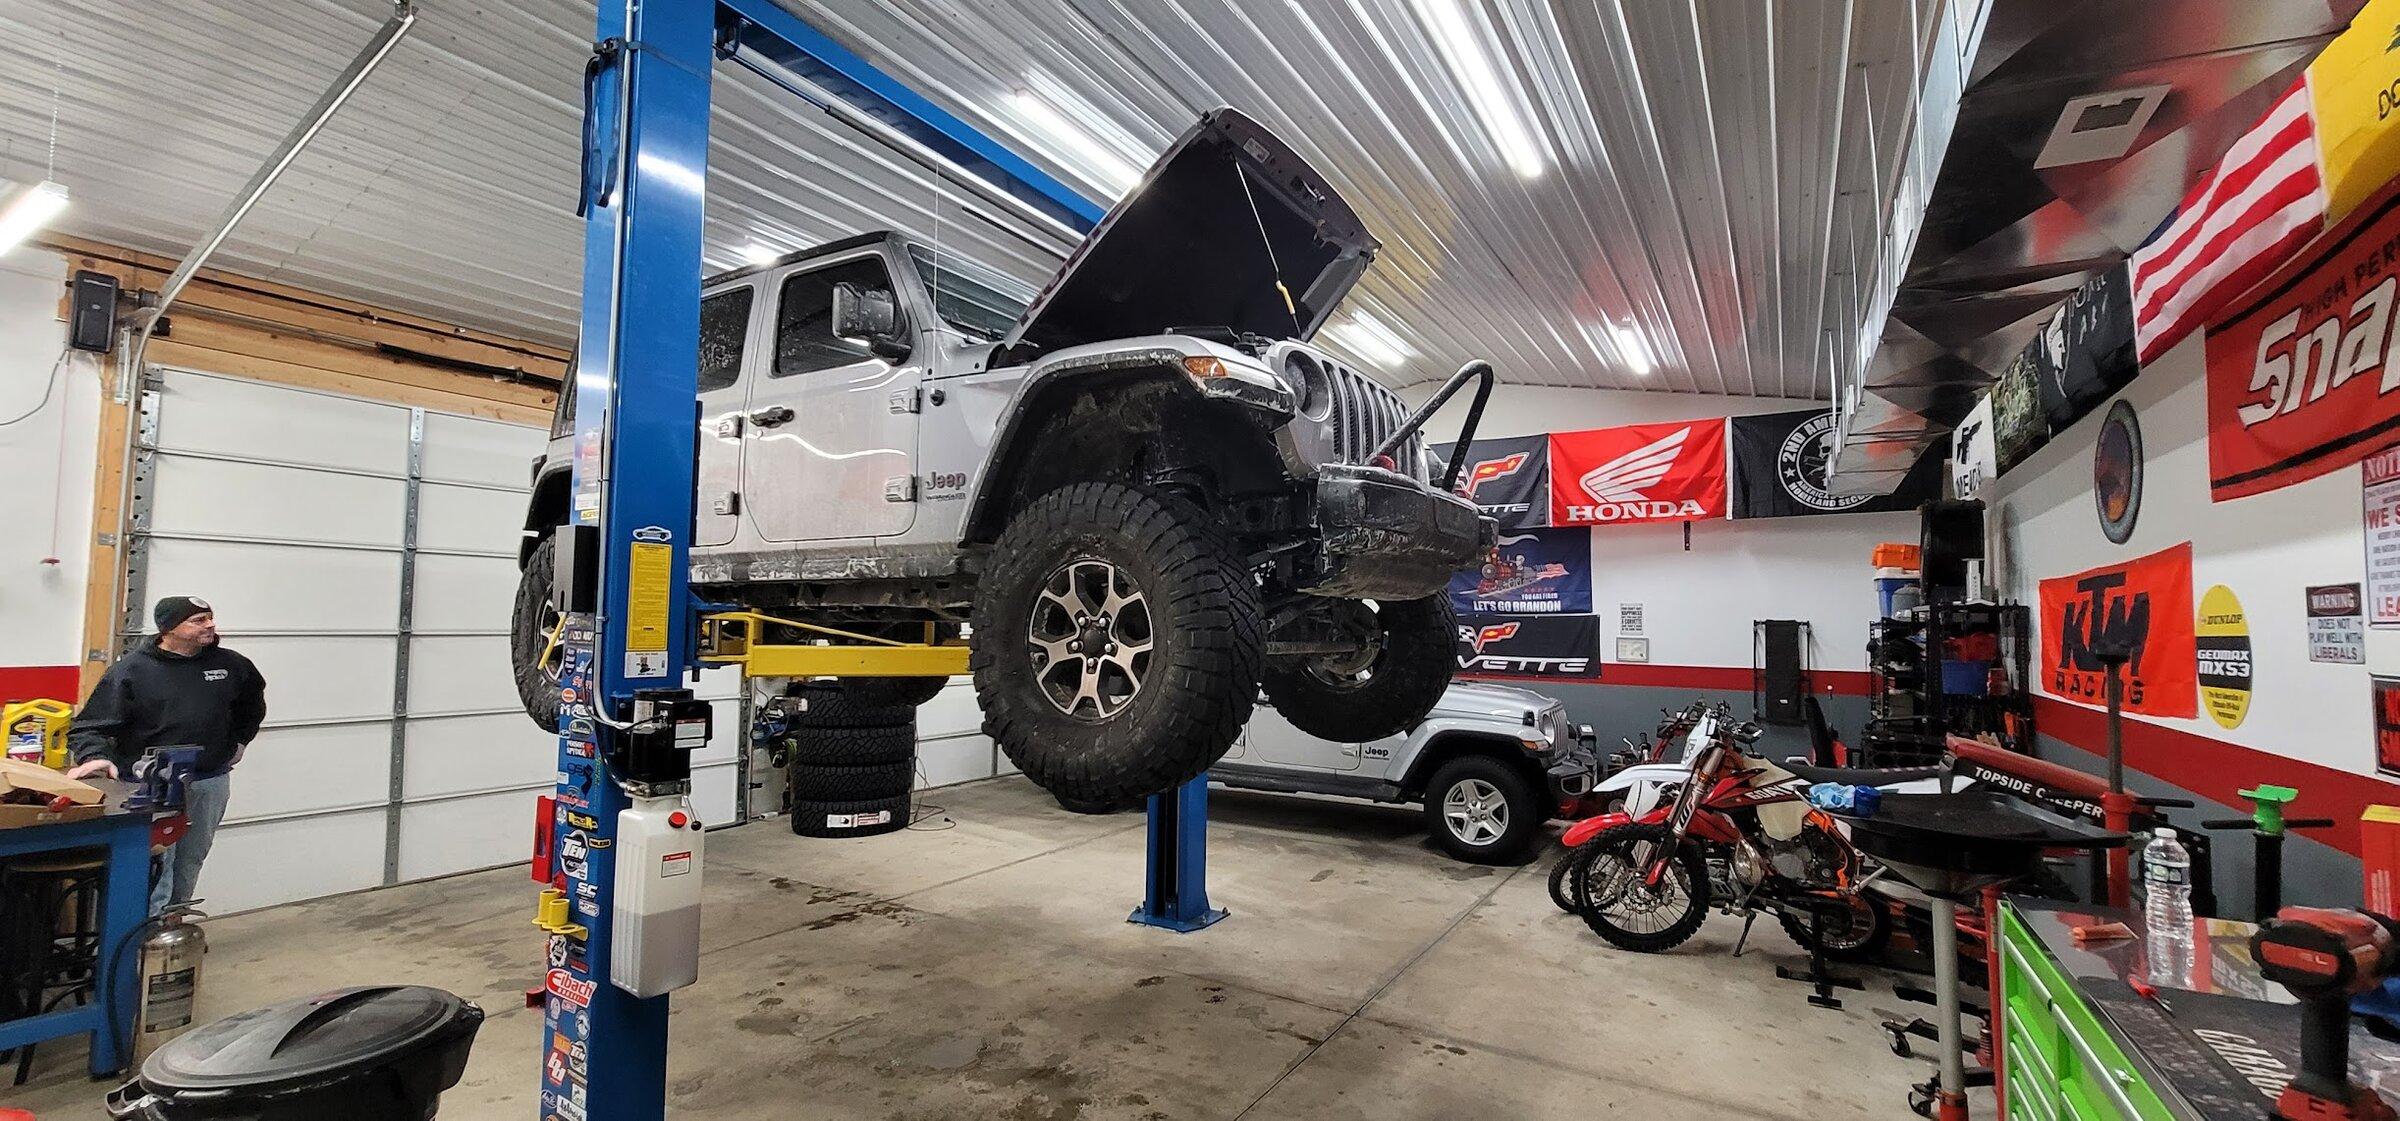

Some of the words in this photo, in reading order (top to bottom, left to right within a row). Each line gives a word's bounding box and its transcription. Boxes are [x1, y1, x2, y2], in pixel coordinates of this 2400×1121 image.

[2354, 232, 2400, 288] PER
[1782, 431, 1807, 463] 2ND
[925, 471, 966, 490] Jeep
[1788, 482, 1836, 507] HOMELAND
[1479, 502, 1530, 513] ETTE
[1566, 499, 1707, 522] HONDA
[2367, 507, 2390, 530] WE
[1473, 600, 1497, 611] LET'S
[1497, 600, 1511, 612] GO
[1512, 600, 1561, 612] BRANDON
[2311, 592, 2354, 609] WARNING
[2058, 571, 2150, 676] KTM
[2207, 614, 2243, 625] DUNLOP
[2318, 618, 2336, 630] DOES
[2337, 618, 2351, 630] NOT
[2326, 632, 2344, 643] WELL
[2197, 649, 2250, 661] GEOMAX
[2314, 646, 2358, 660] LIBERALS
[2198, 660, 2250, 678] MX53
[2055, 671, 2145, 705] RACIG
[1365, 746, 1389, 757] Jeep
[1975, 766, 2033, 794] TOPSIDE
[2035, 788, 2104, 818] CEPER
[547, 969, 593, 998] Eibach
